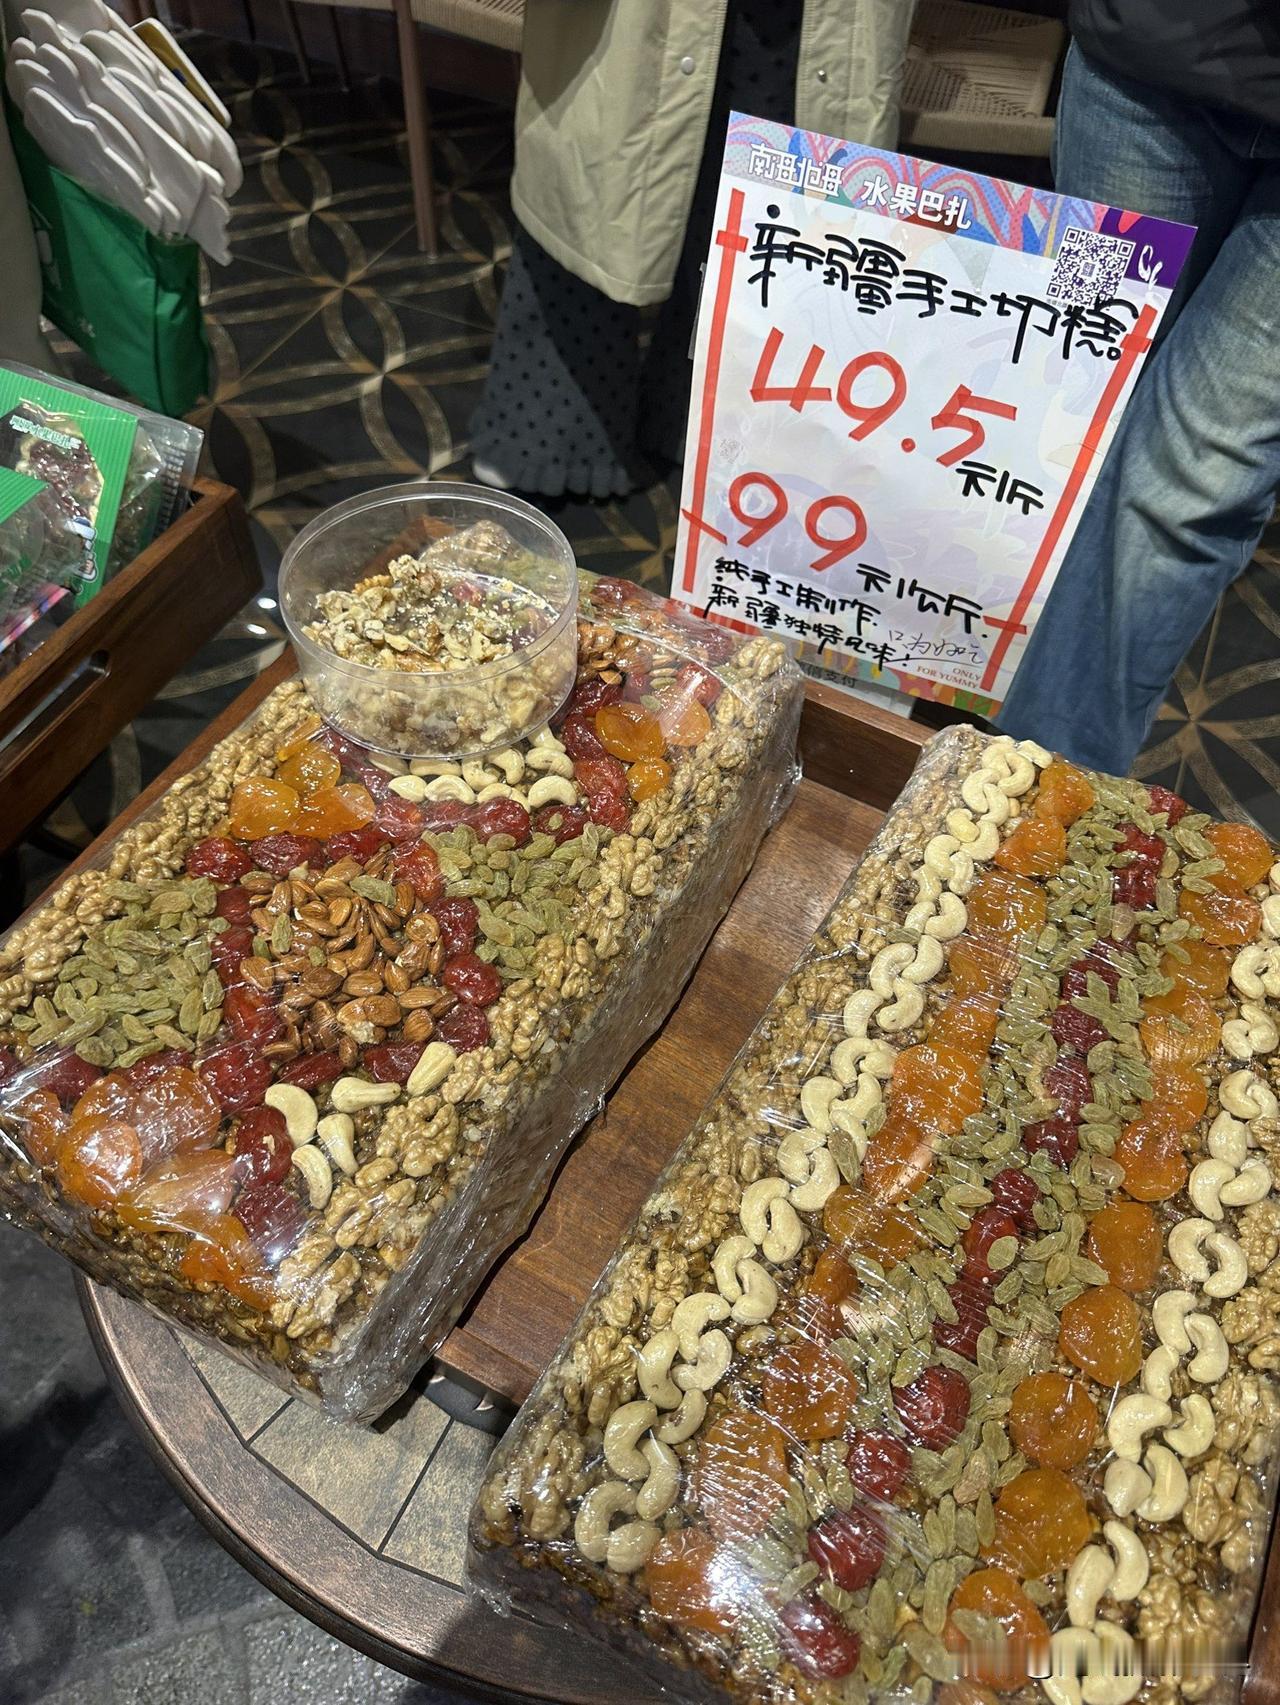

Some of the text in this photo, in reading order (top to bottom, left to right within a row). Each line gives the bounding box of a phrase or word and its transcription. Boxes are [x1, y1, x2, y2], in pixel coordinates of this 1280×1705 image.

[860, 176, 972, 230] 水果巴扎
[750, 326, 1018, 467] 49.5
[729, 471, 867, 572] 99
[917, 665, 977, 689] FOR YUMMY
[952, 667, 981, 681] ONLY
